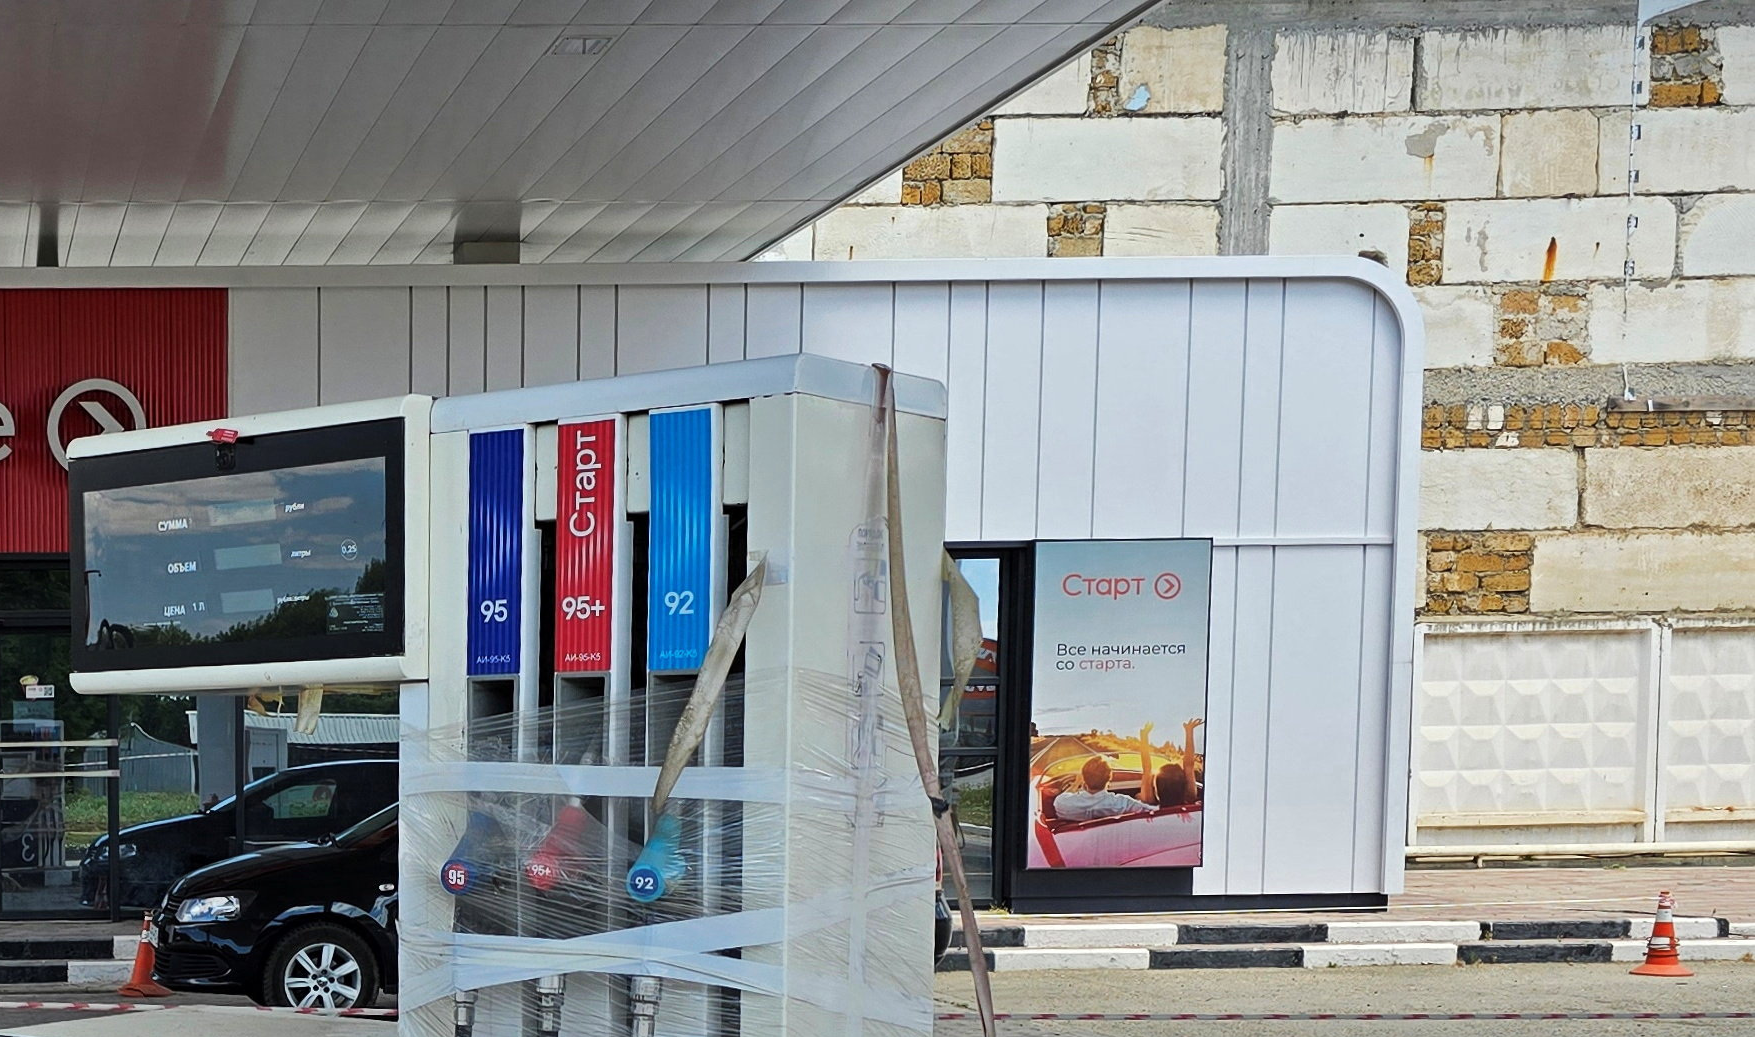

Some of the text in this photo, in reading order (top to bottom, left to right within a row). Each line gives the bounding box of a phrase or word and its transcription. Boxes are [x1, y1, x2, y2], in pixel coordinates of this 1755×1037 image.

[569, 430, 602, 537] Старт
[157, 518, 188, 532] СУММА
[167, 560, 197, 574] ОБЪЕМ
[1061, 573, 1146, 601] Старт
[163, 604, 186, 618] ЦЕНА
[480, 598, 508, 623] 95
[561, 595, 606, 621] 95+
[663, 590, 695, 616] 92
[1056, 642, 1186, 657] Все начинается
[1055, 656, 1136, 672] со старта.
[448, 869, 466, 886] 95
[531, 863, 552, 876] 95+
[634, 876, 655, 890] 92
